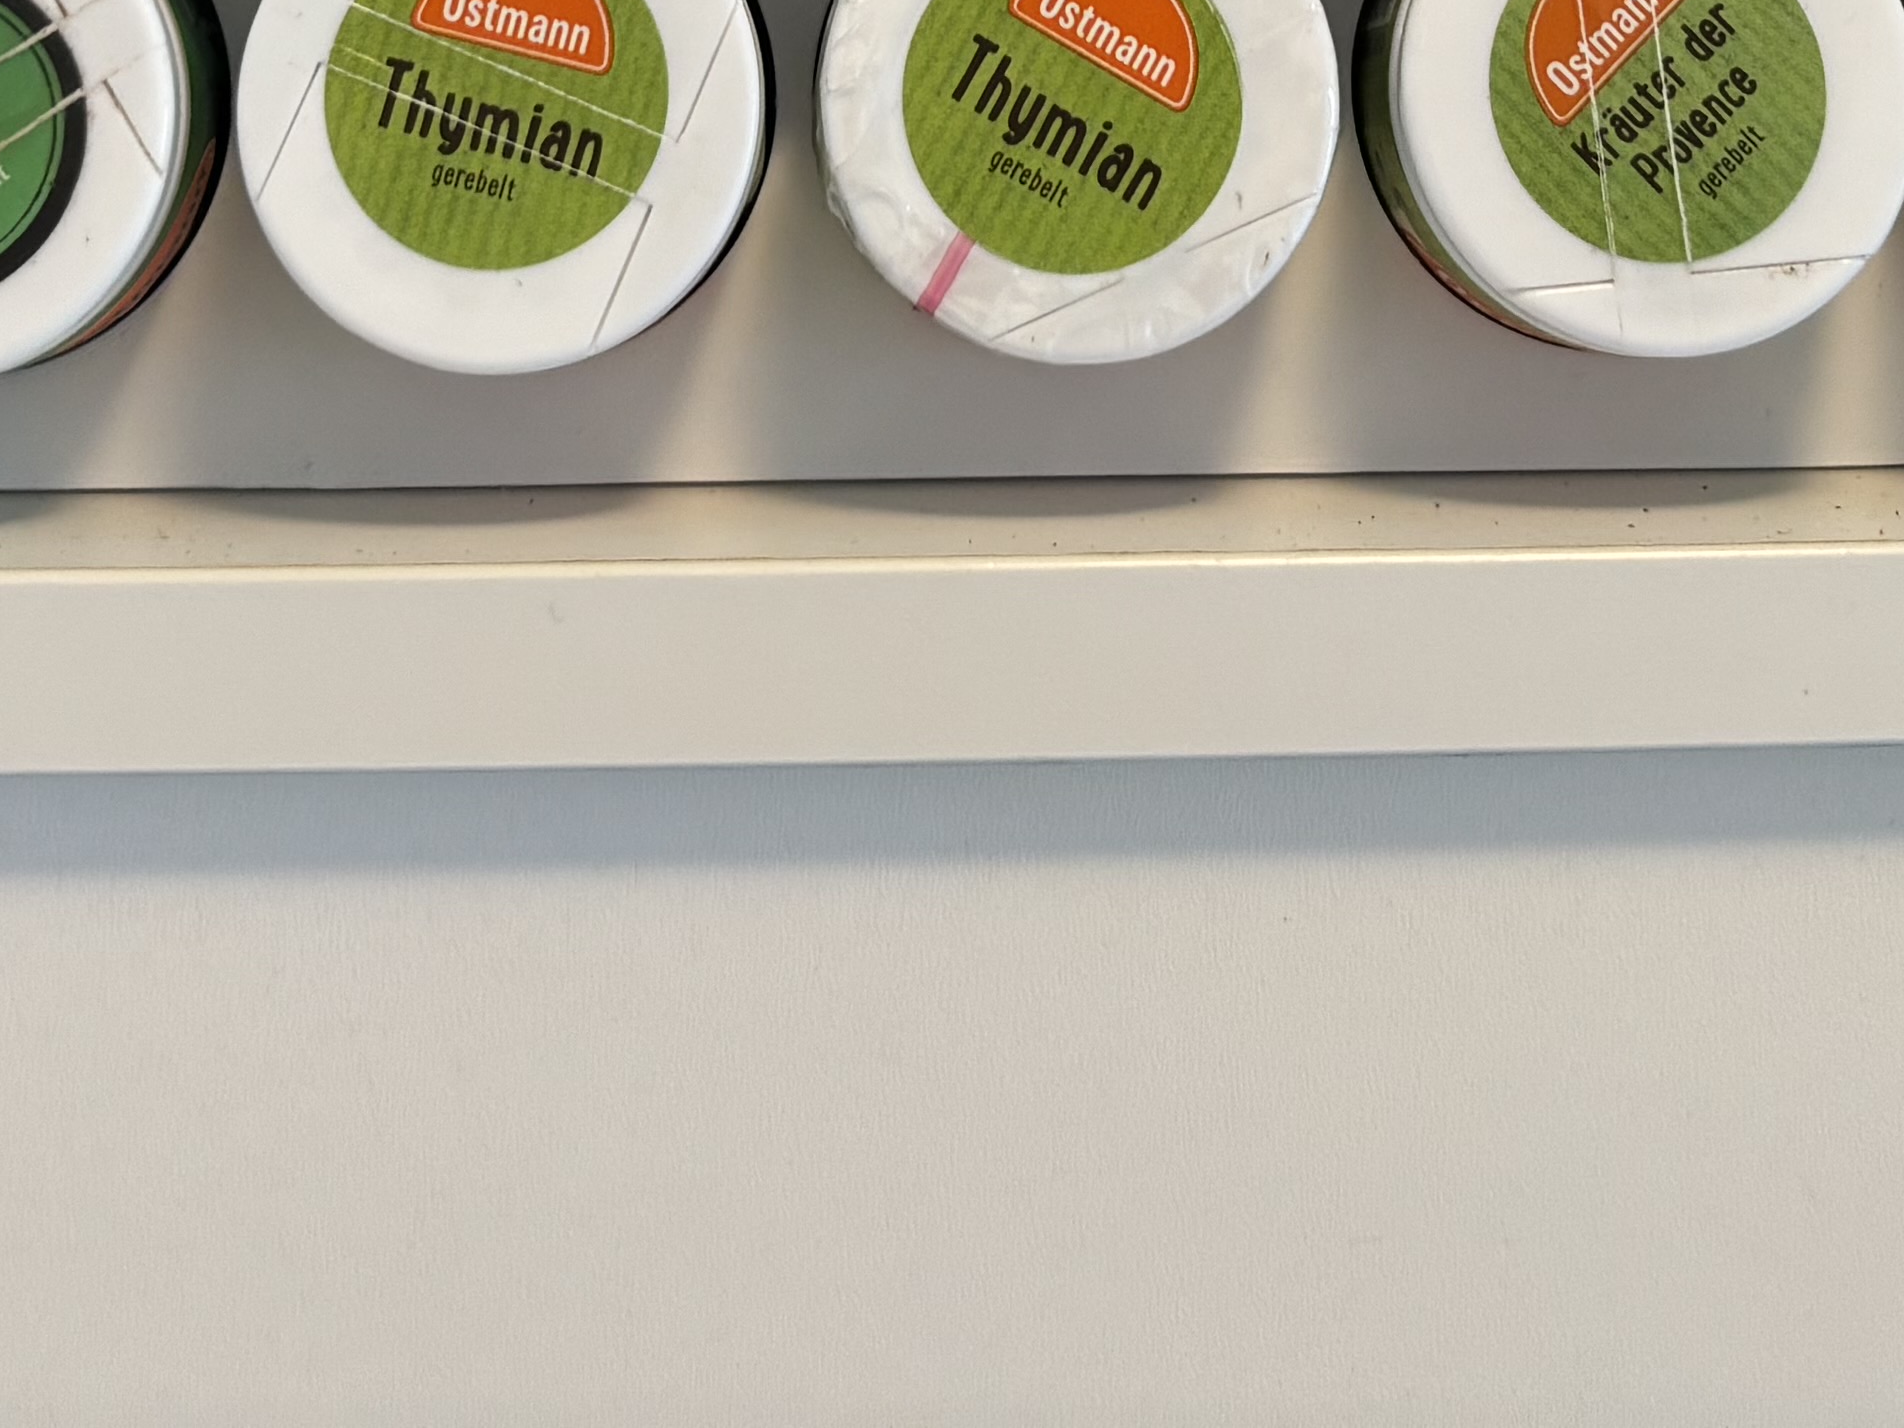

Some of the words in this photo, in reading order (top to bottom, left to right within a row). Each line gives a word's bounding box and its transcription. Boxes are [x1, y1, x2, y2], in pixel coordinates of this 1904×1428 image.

[377, 56, 604, 178] Thymian
[951, 33, 1163, 211] Thymian
[1570, 55, 1686, 176] Kräuter
[1680, 3, 1736, 62] der
[1630, 65, 1758, 194] Provence
[431, 160, 516, 201] gerebelt
[988, 150, 1069, 208] gerebelt
[1698, 124, 1766, 200] gerebelt
